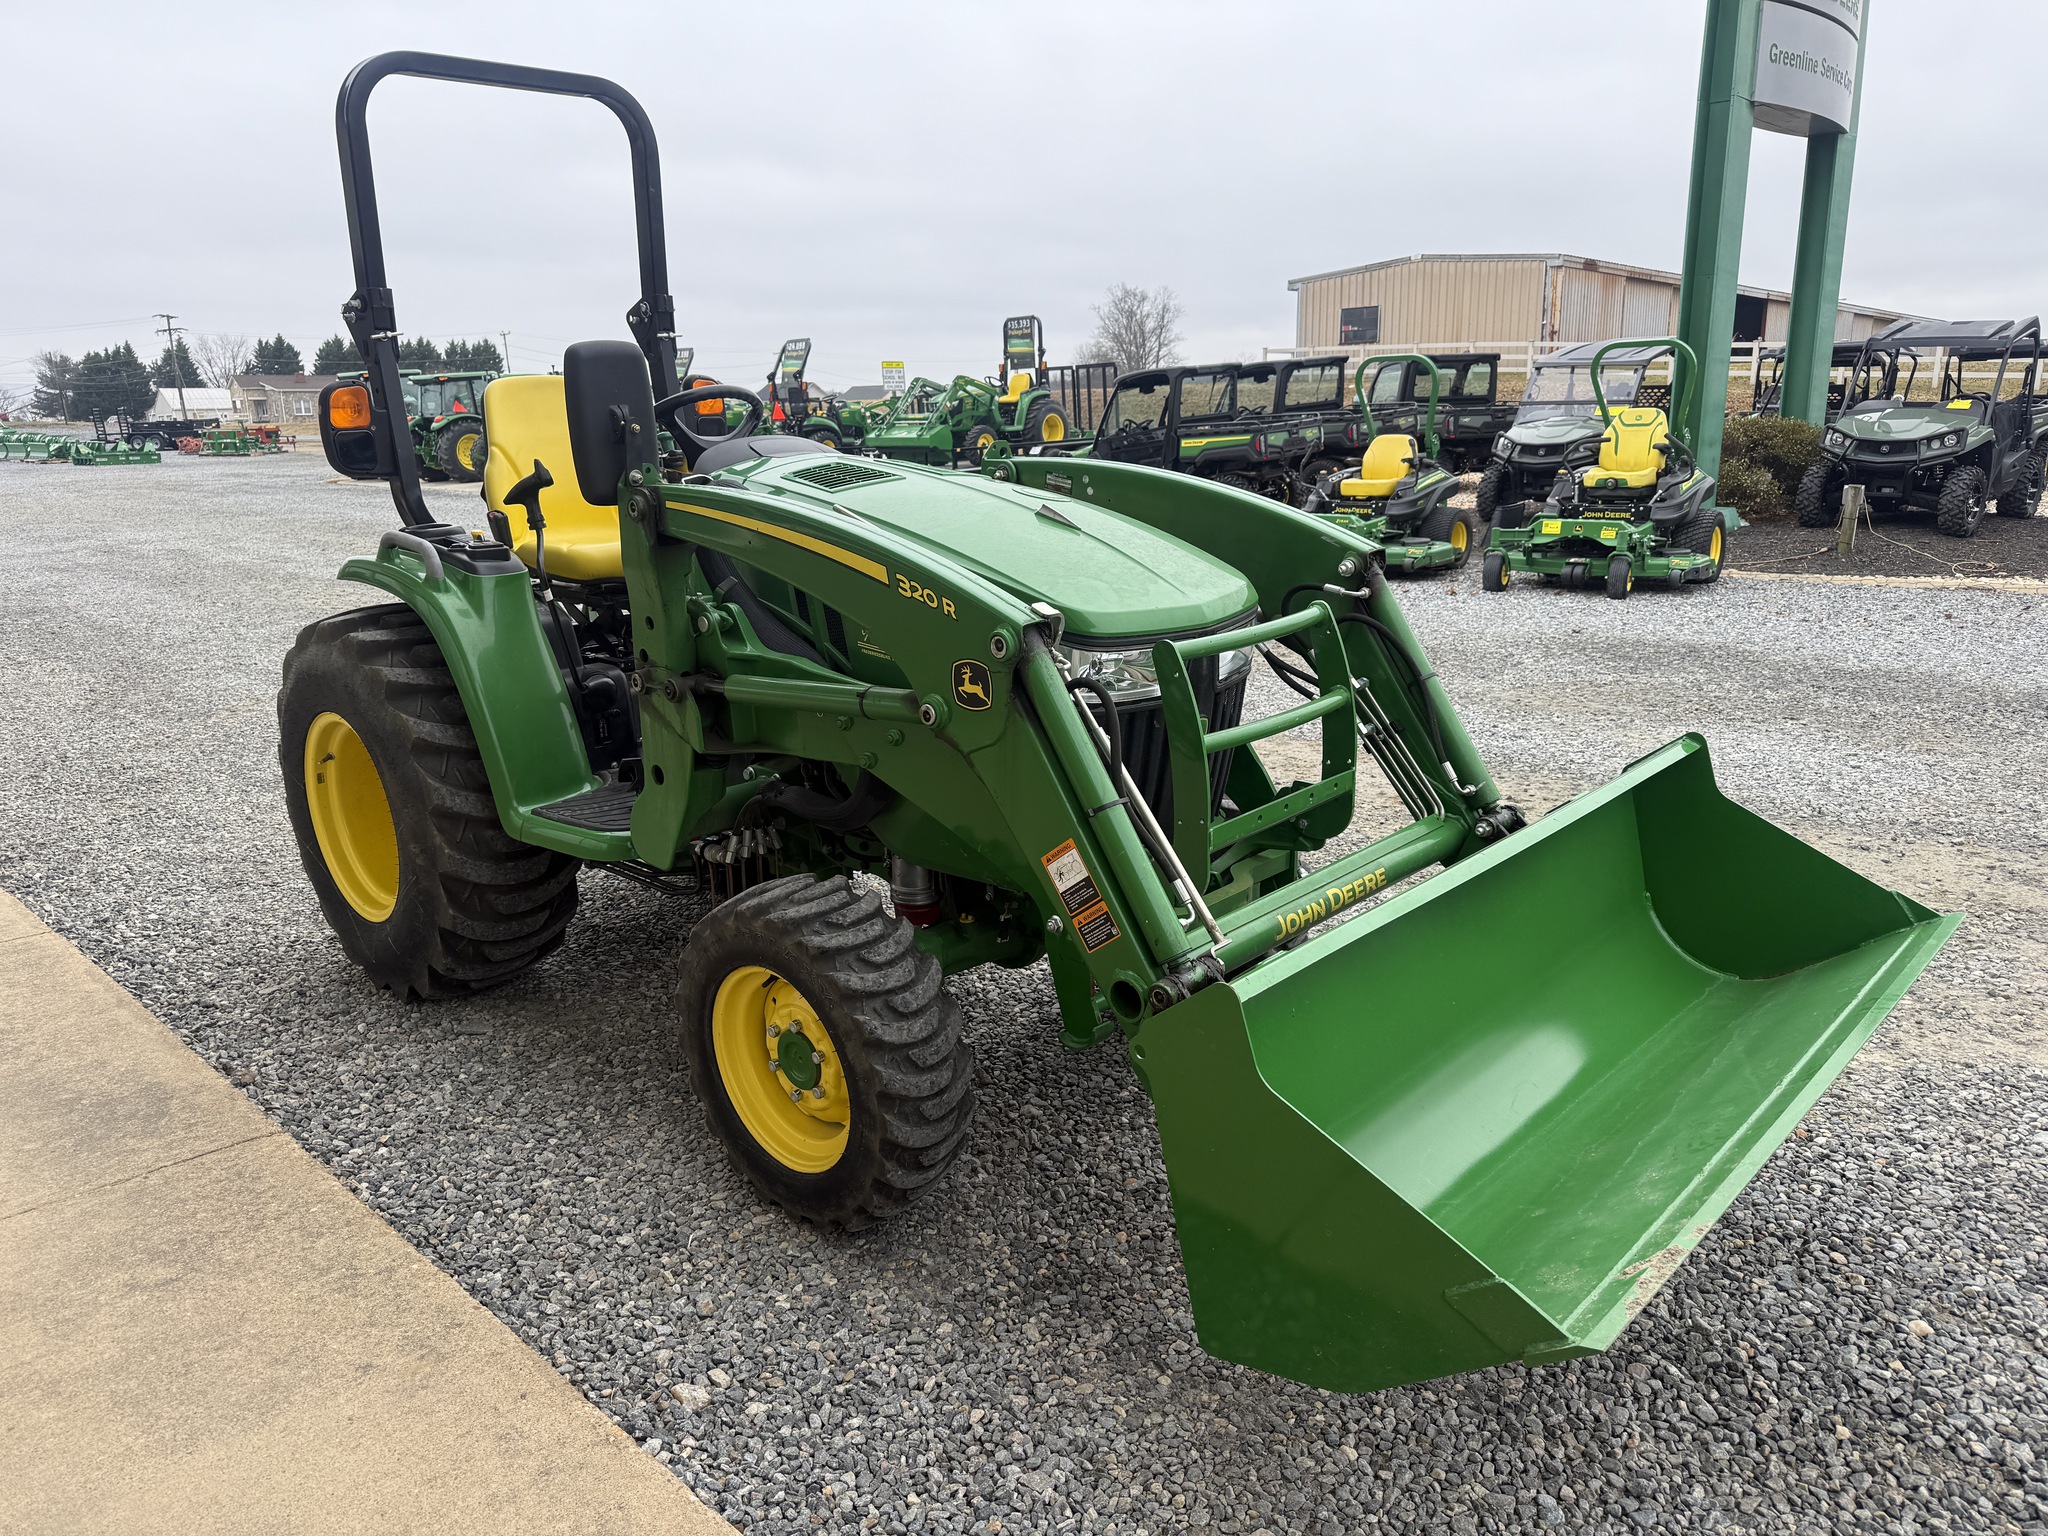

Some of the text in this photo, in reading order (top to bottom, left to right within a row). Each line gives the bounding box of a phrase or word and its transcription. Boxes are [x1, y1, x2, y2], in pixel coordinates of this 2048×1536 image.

[1769, 43, 1819, 74] Greenline
[1820, 57, 1844, 86] Service
[895, 573, 957, 619] 320 R
[1050, 842, 1072, 859] WARNING
[1082, 905, 1105, 922] WARNING
[1275, 867, 1388, 941] JOHN DEERE
